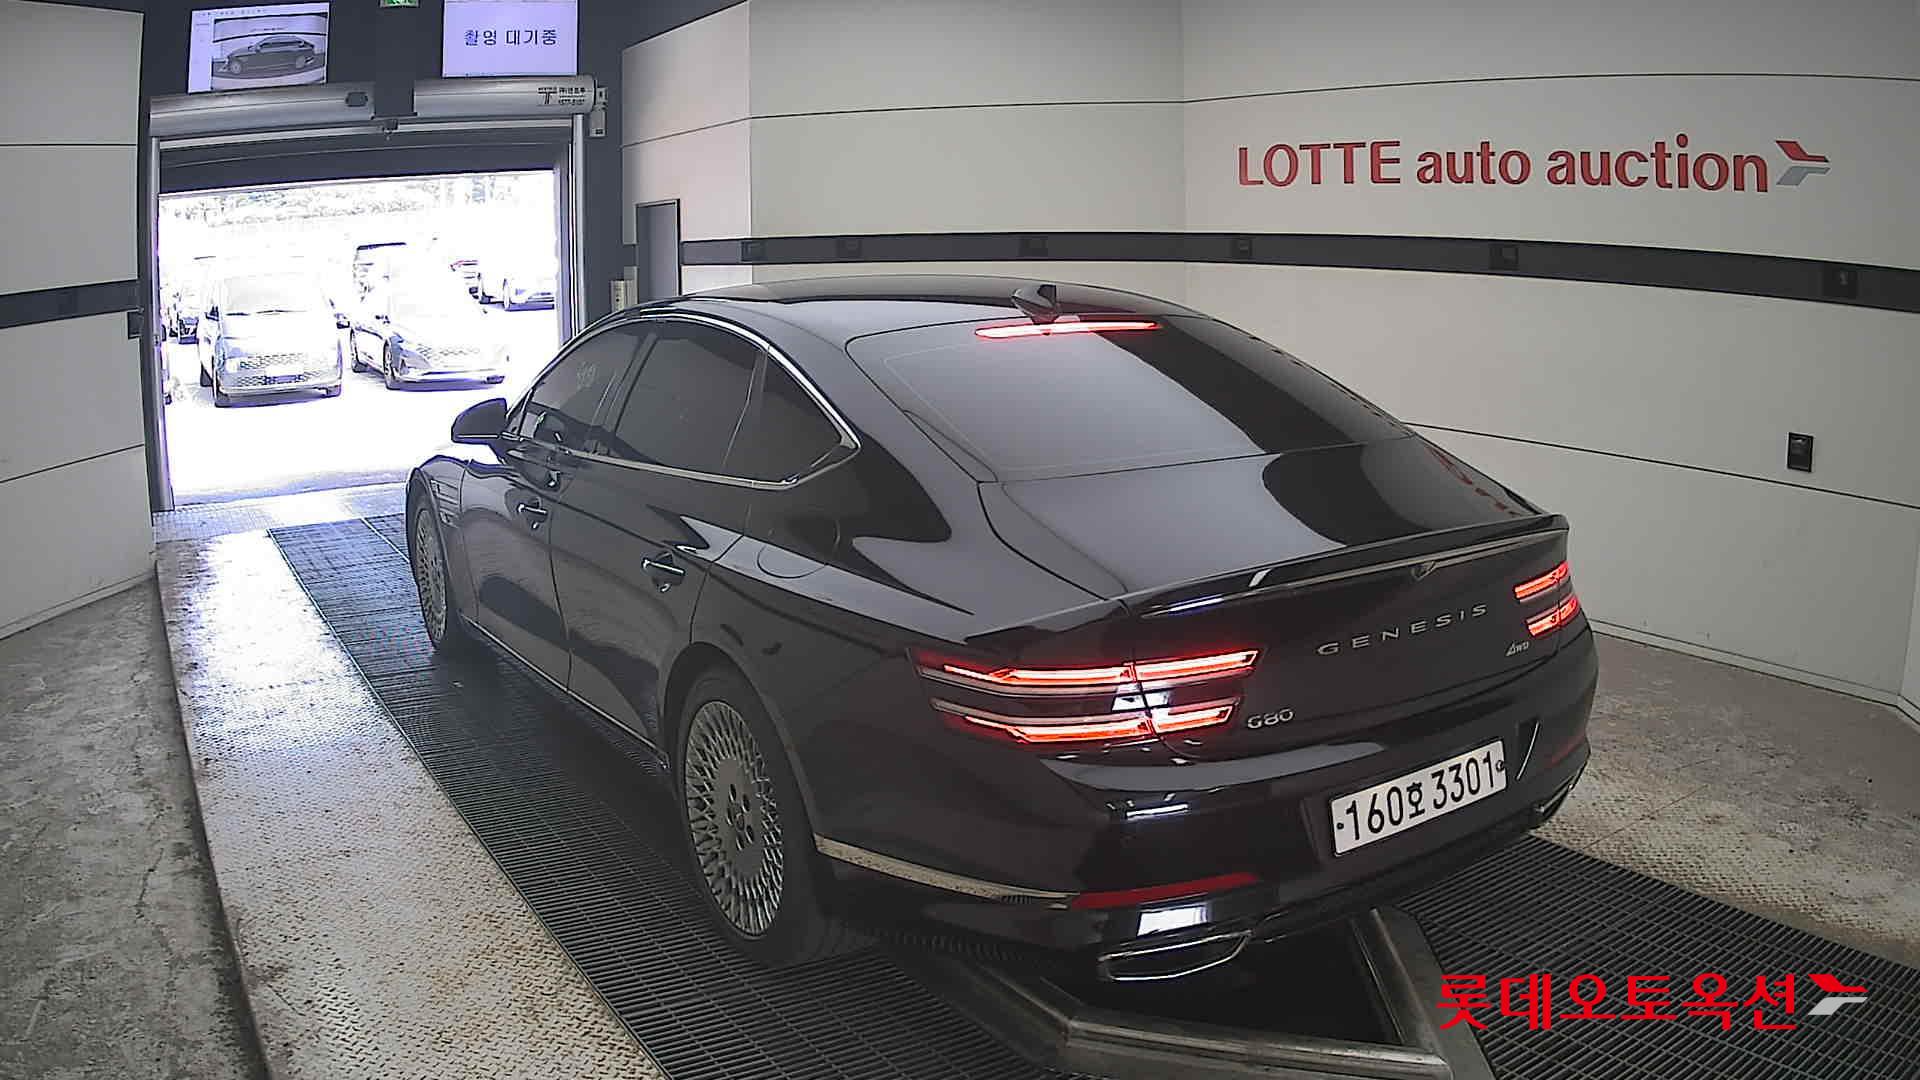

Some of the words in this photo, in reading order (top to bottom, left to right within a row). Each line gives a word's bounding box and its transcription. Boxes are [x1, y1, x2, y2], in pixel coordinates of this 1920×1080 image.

[505, 29, 557, 46] 대기중
[1238, 140, 1401, 187] LOTTE
[1416, 141, 1531, 185] auto
[1547, 133, 1768, 193] auction
[1317, 603, 1488, 656] GENESIS
[1247, 708, 1294, 729] G80
